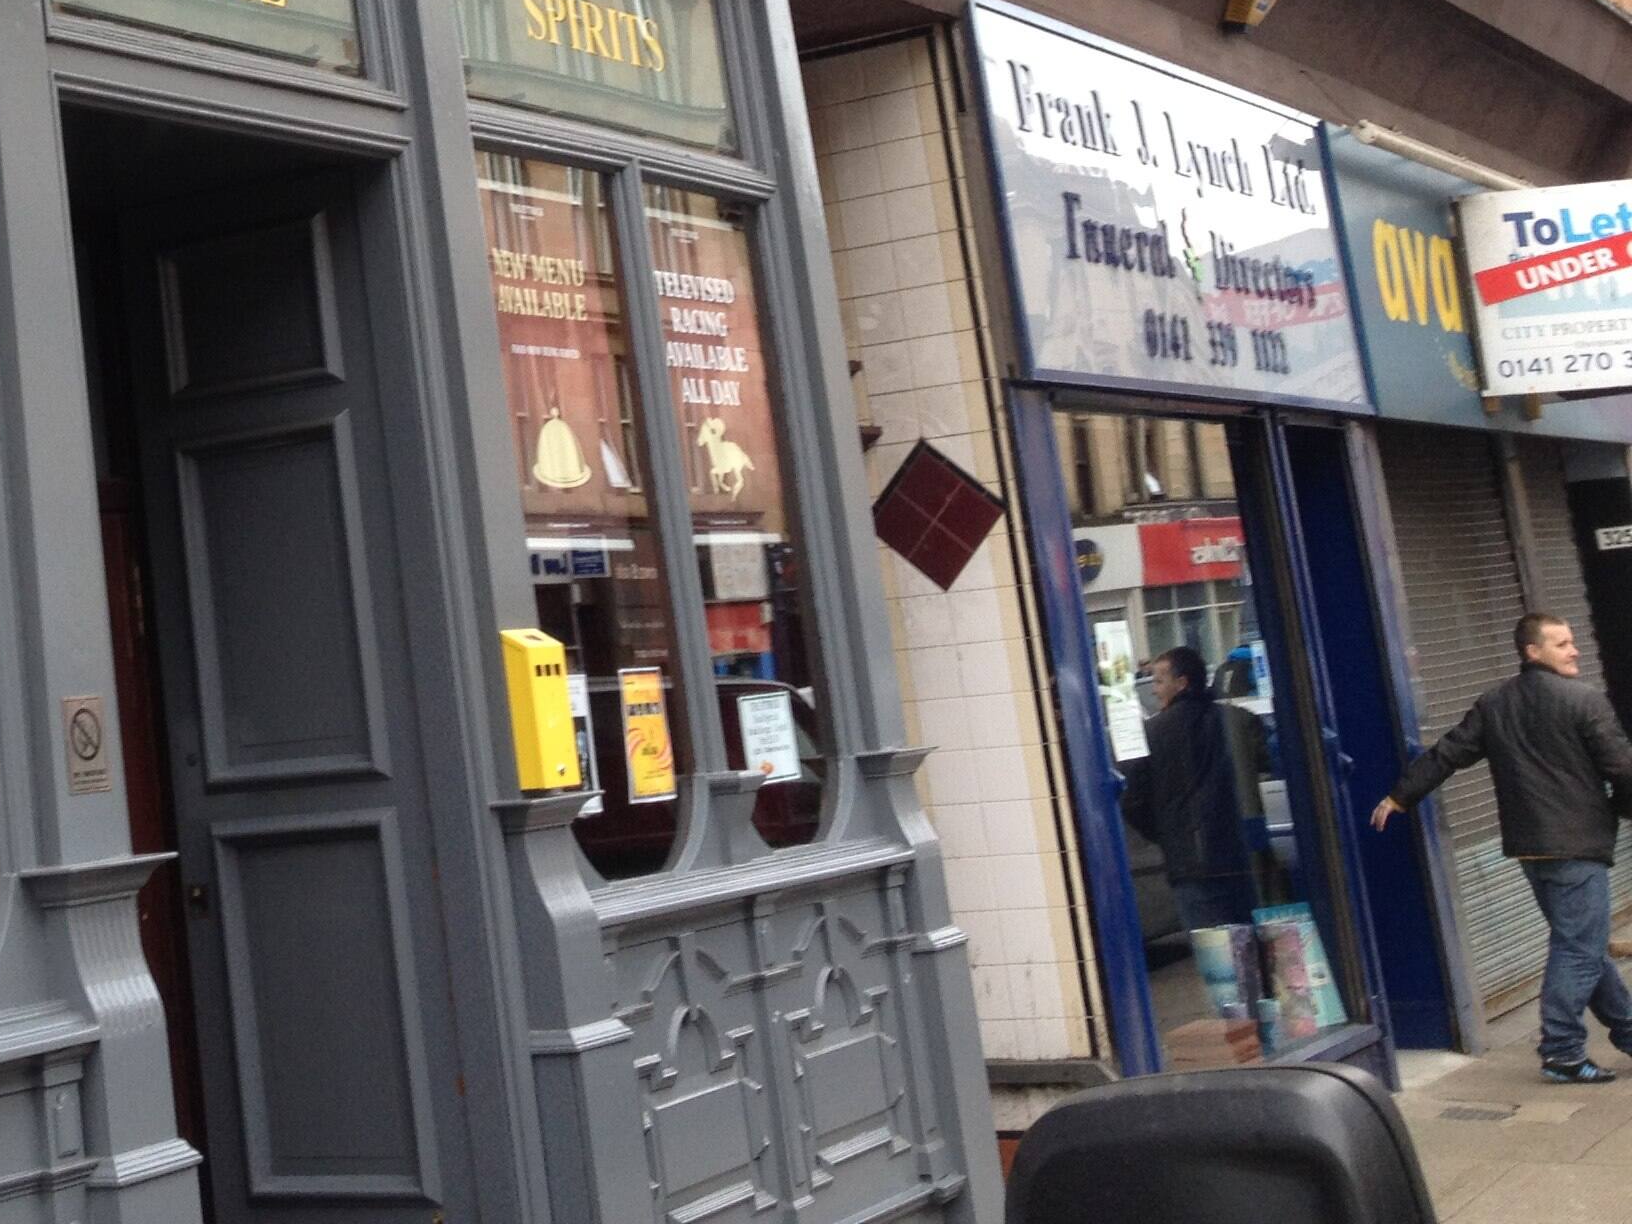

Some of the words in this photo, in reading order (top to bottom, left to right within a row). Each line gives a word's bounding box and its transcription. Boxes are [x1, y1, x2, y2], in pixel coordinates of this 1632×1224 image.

[1007, 58, 1122, 157] Frank
[1163, 111, 1254, 199] Lynch
[531, 254, 586, 287] MENU
[1515, 247, 1619, 290] UNDER
[497, 284, 588, 321] AVAILABLE
[652, 270, 736, 304] TELEVISED
[670, 307, 729, 337] RACING
[666, 341, 750, 373] AVAILABLE
[1498, 357, 1555, 378] 0141
[1563, 352, 1613, 374] 270
[682, 378, 711, 405] ALL
[711, 380, 741, 406] DAY
